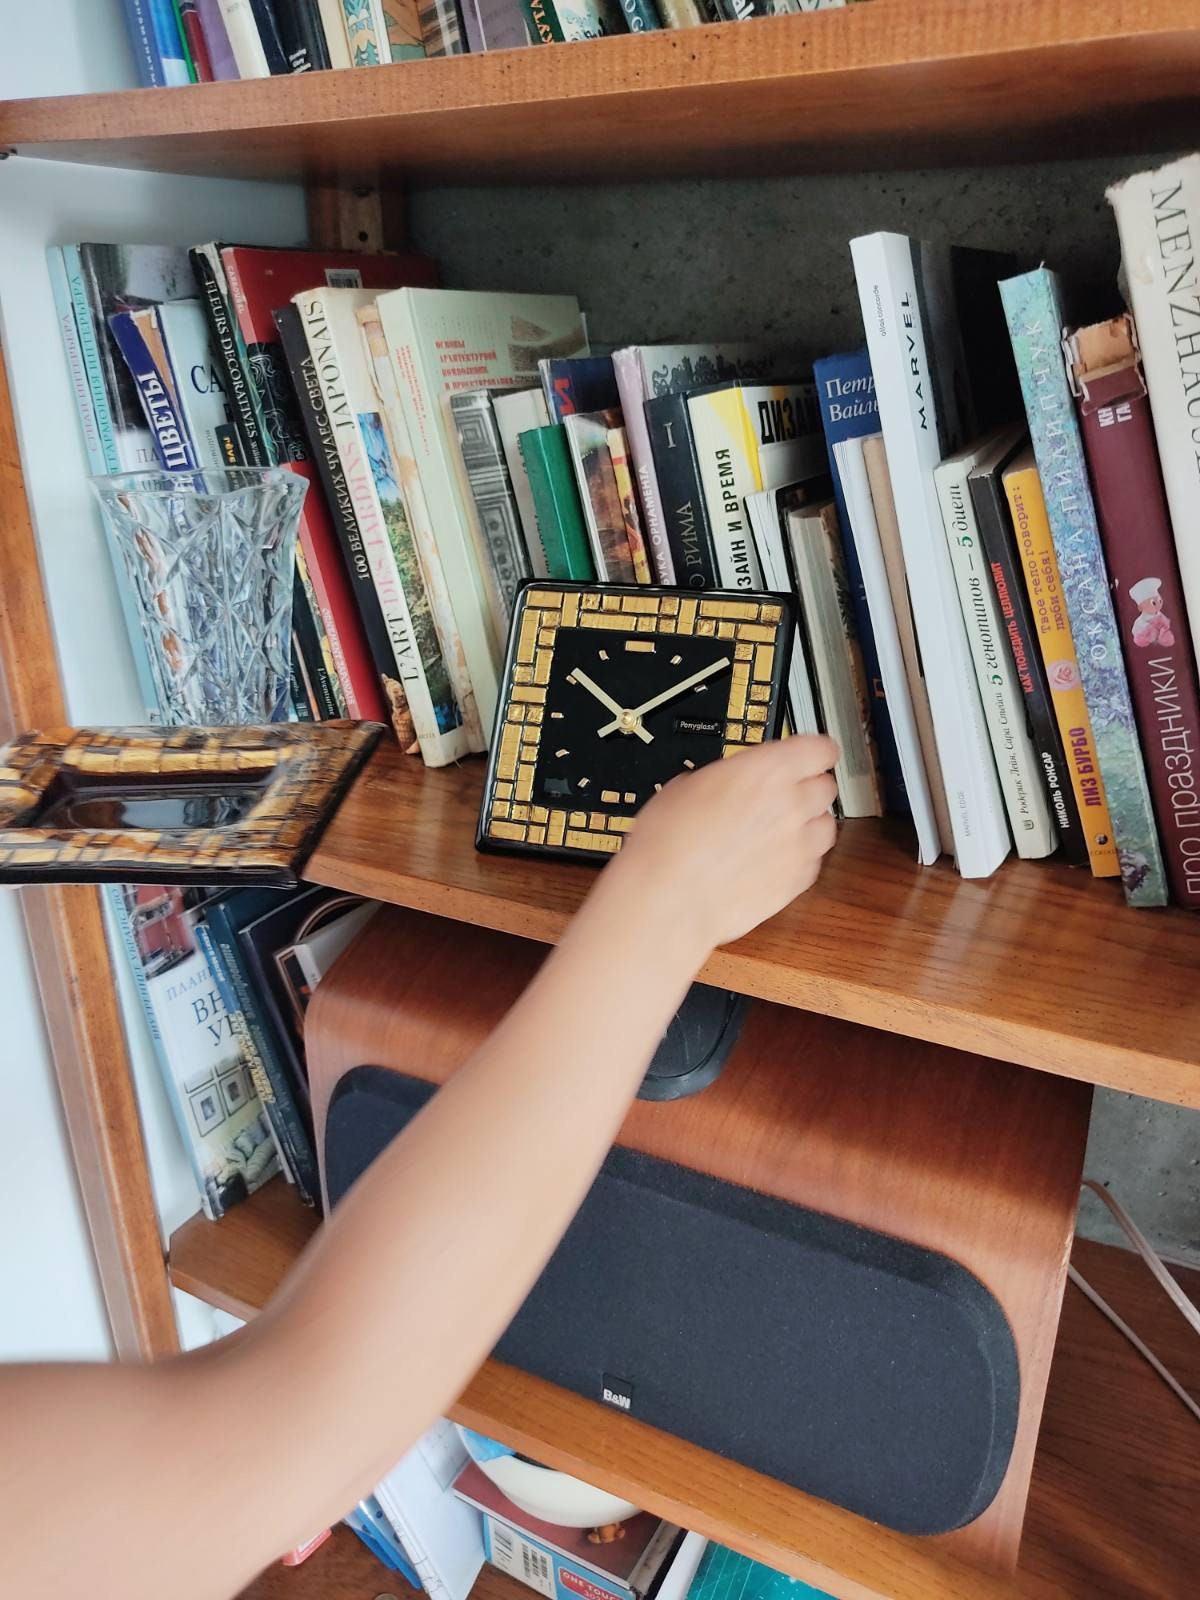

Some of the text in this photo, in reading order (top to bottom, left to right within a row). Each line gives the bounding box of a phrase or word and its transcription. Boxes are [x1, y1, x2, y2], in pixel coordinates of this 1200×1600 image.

[71, 276, 98, 369] ИНТЕРЬЕРА
[204, 280, 228, 334] FLEURS
[222, 340, 257, 438] DECORATIVES
[435, 340, 465, 349] ОСНОВЫ
[439, 350, 497, 363] АРХИТЕКТУРНОЙ
[901, 292, 928, 430] MARVEL
[1150, 180, 1200, 484] MENZHAU
[306, 300, 354, 431] JAPONAIS
[138, 371, 188, 468] ЦВЕТЫ
[758, 385, 822, 443] ДИЗАЙ
[300, 357, 369, 579] 100 ВЕЛИКИХ ЧУДЕС СВЕТА
[344, 441, 382, 550] JARDINS
[639, 465, 661, 544] ОРНАМЕНТА
[715, 449, 739, 512] ВРЕМЯ
[950, 484, 968, 532] диет
[1025, 321, 1107, 660] ОКСАНА ПИЛИПЧУК
[676, 501, 703, 566] РИМА
[728, 521, 741, 531] И
[961, 534, 974, 550] 5
[1012, 486, 1052, 633] Твое тело говорит:
[969, 578, 996, 669] генотипов
[991, 562, 1035, 693] КАК ПОБЕДИТЬ ЦЕЛЛЮЛИТ
[1042, 550, 1065, 631] люби себя!
[388, 613, 418, 681] L'ART
[988, 673, 1003, 686] 5
[680, 720, 715, 731] Ponyglass
[1147, 656, 1200, 828] праздники
[1042, 752, 1071, 828] НИКОЛЬ РОНСАР
[1069, 727, 1101, 808] ЛИЗ БУРБО
[602, 1388, 632, 1409] B&W
[562, 1571, 585, 1589] ONE
